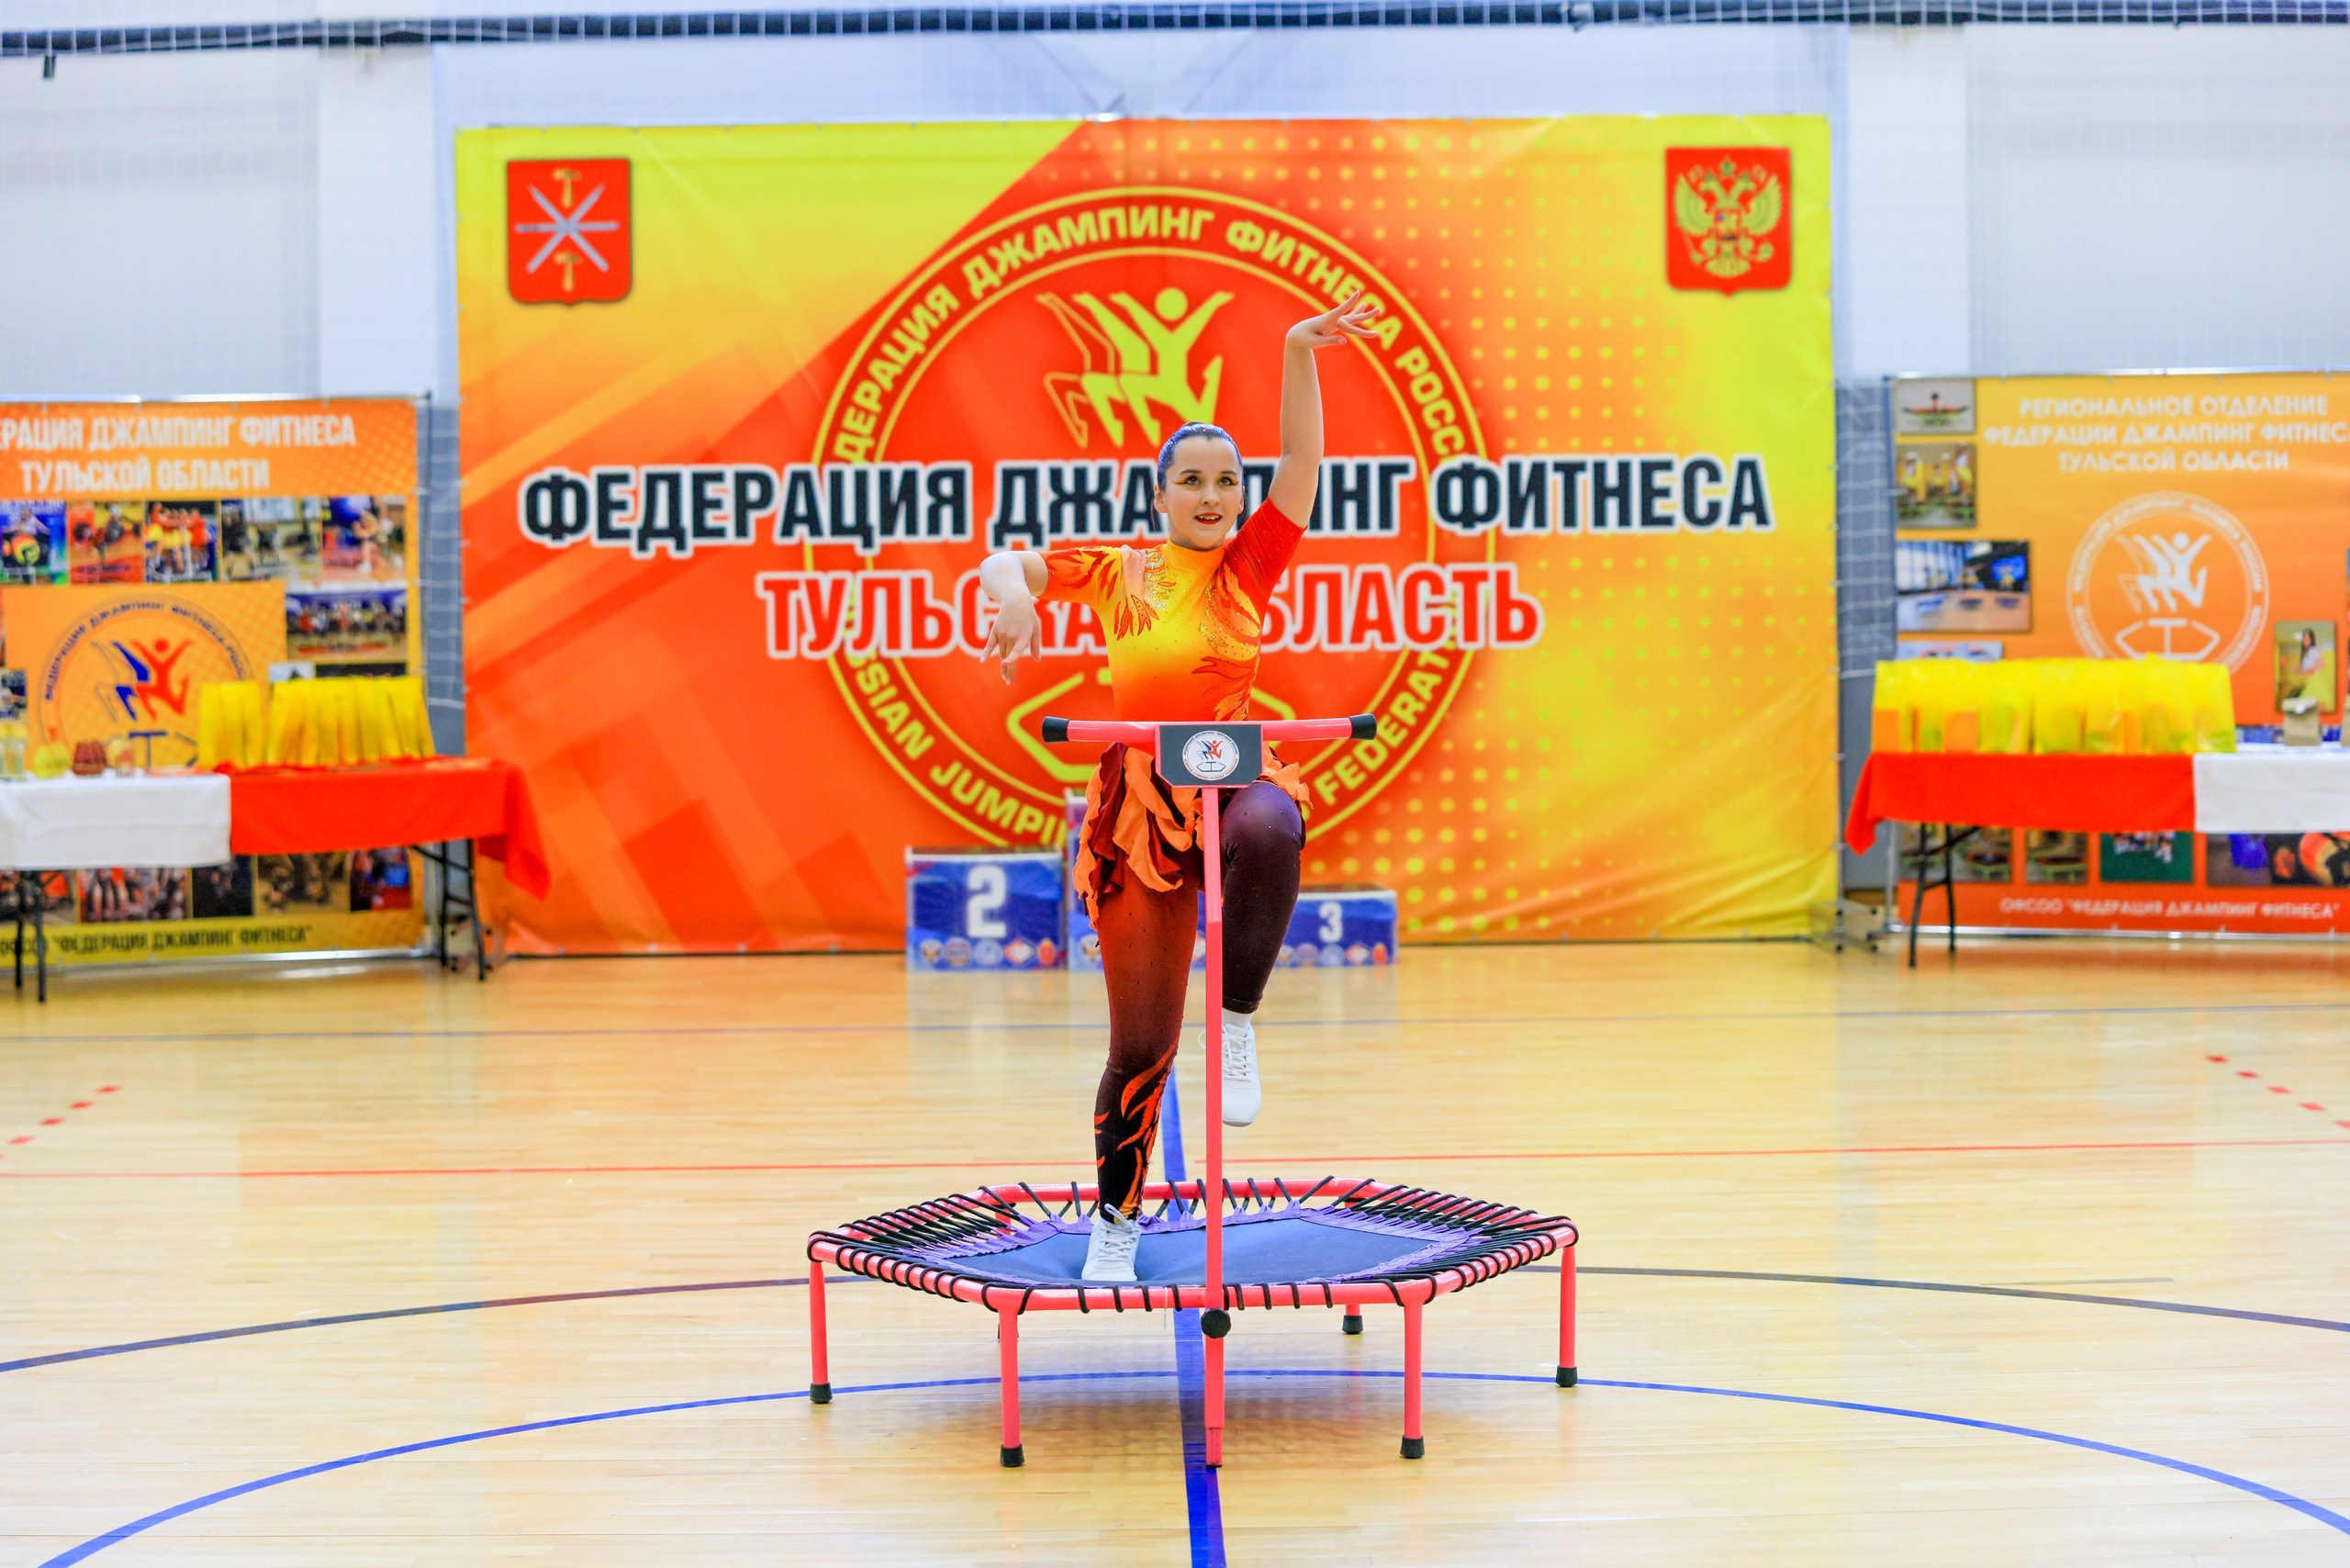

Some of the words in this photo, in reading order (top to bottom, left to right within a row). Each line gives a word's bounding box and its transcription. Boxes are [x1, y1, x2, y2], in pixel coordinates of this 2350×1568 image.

[834, 285, 960, 463] ДЕРАЦИЯ
[960, 206, 1215, 299] ДЖАМПИНГ
[1394, 346, 1466, 464] РОСС
[2020, 397, 2193, 418] РЕГИОНАЛЬНОЕ
[2199, 396, 2327, 417] ОТДЕЛЕНИЕ
[89, 417, 235, 451] ДЖАМПИНГ
[240, 415, 356, 447] ФИТНЕСА
[2122, 422, 2253, 444] ДЖАМПИНГ
[2260, 421, 2350, 443] ФИТНЕС
[20, 455, 151, 493] ТУЛЬСКОЙ
[158, 458, 270, 491] ОБЛАСТИ
[2058, 447, 2176, 472] ТУЛЬСКОЙ
[2182, 450, 2289, 471] ОБЛАСТИ
[521, 464, 969, 555] ФЕДЕРАЦИЯ
[1433, 456, 1774, 532] ФИТНЕСА
[929, 760, 1067, 846] JUMPI
[1313, 647, 1450, 805] FEDERAT
[968, 865, 1007, 938] 2
[1318, 901, 1343, 944] 3
